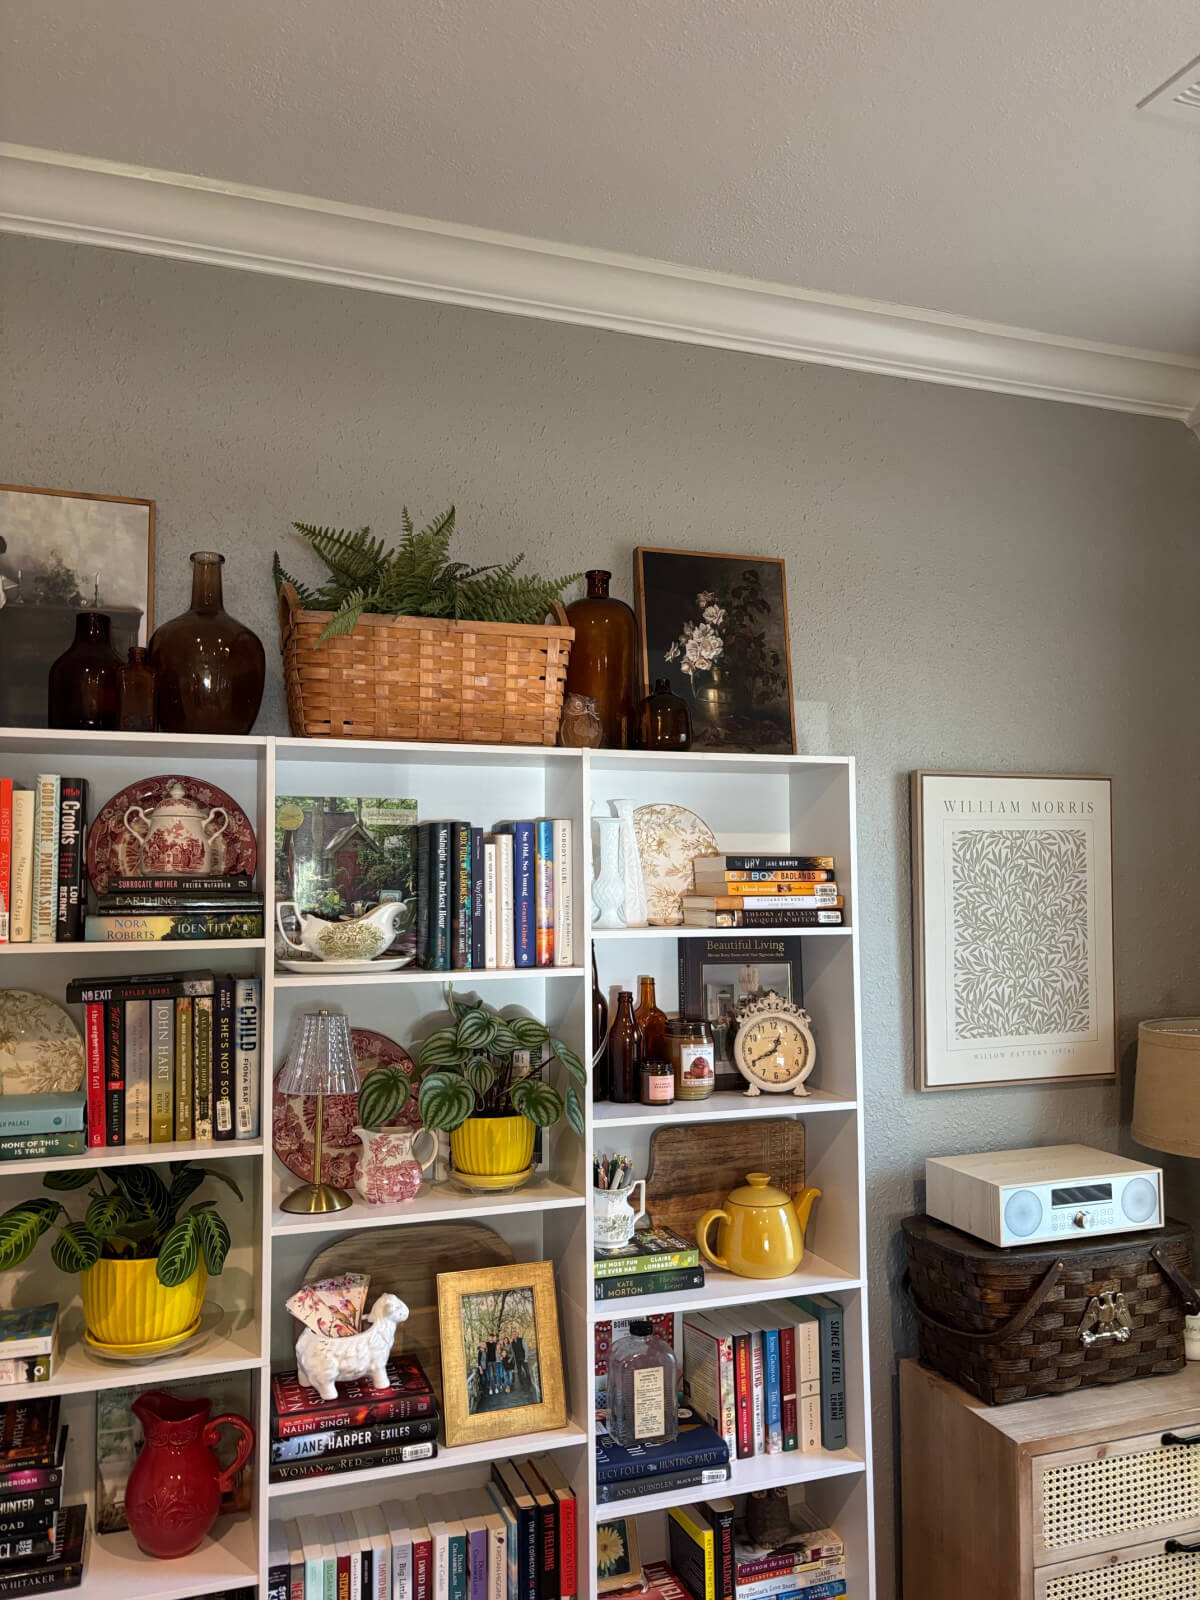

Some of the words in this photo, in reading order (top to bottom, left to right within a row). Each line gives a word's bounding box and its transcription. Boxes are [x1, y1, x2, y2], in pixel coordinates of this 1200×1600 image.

[41, 782, 55, 808] GOOD
[944, 800, 1021, 814] WILLIAM
[1031, 801, 1095, 814] MORRIS
[1, 808, 9, 843] INSIDE
[40, 810, 54, 843] PEOPLE
[61, 800, 81, 845] Crooks
[438, 830, 447, 861] Midnight
[522, 832, 529, 842] So
[1, 852, 9, 876] ALIX
[522, 861, 529, 871] So
[39, 853, 53, 898] PATMEENA
[119, 880, 153, 889] SURROGATE
[155, 880, 178, 889] MOTHER
[521, 873, 529, 897] Young
[751, 872, 776, 880] BOX
[781, 872, 816, 880] BADLANDS
[59, 886, 68, 922] BERNEY
[70, 886, 78, 904] LOU
[439, 881, 447, 908] Darkest
[474, 880, 483, 917] Wayfinding
[38, 901, 51, 927] SABIT
[439, 910, 447, 929] Hour
[115, 919, 148, 929] NORA
[178, 923, 233, 934] IDENTITY
[107, 931, 155, 940] ROBERTS
[707, 940, 752, 950] Beautiful
[754, 939, 784, 951] Living
[95, 990, 113, 1000] EXIT
[244, 988, 254, 1002] THE
[157, 1006, 169, 1041] JOHN
[220, 1017, 229, 1049] SHE'S
[240, 1006, 257, 1052] CHILD
[770, 1022, 777, 1030] 12
[111, 1056, 120, 1080] NAME
[158, 1046, 169, 1081] HART
[221, 1053, 229, 1075] NOT
[762, 1068, 766, 1076] 7
[1, 1142, 25, 1150] NONE
[25, 1147, 46, 1155] TRUE
[608, 1288, 644, 1298] MORTON
[830, 1320, 840, 1346] SINCE
[769, 1336, 777, 1353] JOHN
[832, 1350, 841, 1363] WE
[832, 1366, 841, 1385] FELL
[283, 1423, 316, 1435] NALINI
[320, 1418, 350, 1429] SINGH
[295, 1439, 323, 1456] JANE
[327, 1432, 372, 1450] HARPER
[380, 1426, 410, 1440] EXILES
[280, 1466, 324, 1478] WOMAN
[340, 1459, 363, 1469] RED
[621, 1465, 645, 1476] FOLEY
[660, 1456, 694, 1470] HUNTING
[695, 1451, 718, 1463] PARTY
[617, 1488, 636, 1497] ANNA
[544, 1513, 555, 1528] JOY
[722, 1528, 731, 1554] DAVID
[544, 1530, 555, 1572] FIELDING
[378, 1564, 387, 1586] DAVID
[398, 1562, 407, 1577] Big
[418, 1560, 426, 1584] DAVID
[722, 1555, 732, 1594] BALDACCI
[809, 1574, 837, 1584] MORIARTY
[815, 1570, 831, 1578] LIANE
[1, 1574, 55, 1591] WHITAKER
[399, 1578, 407, 1600] Little
